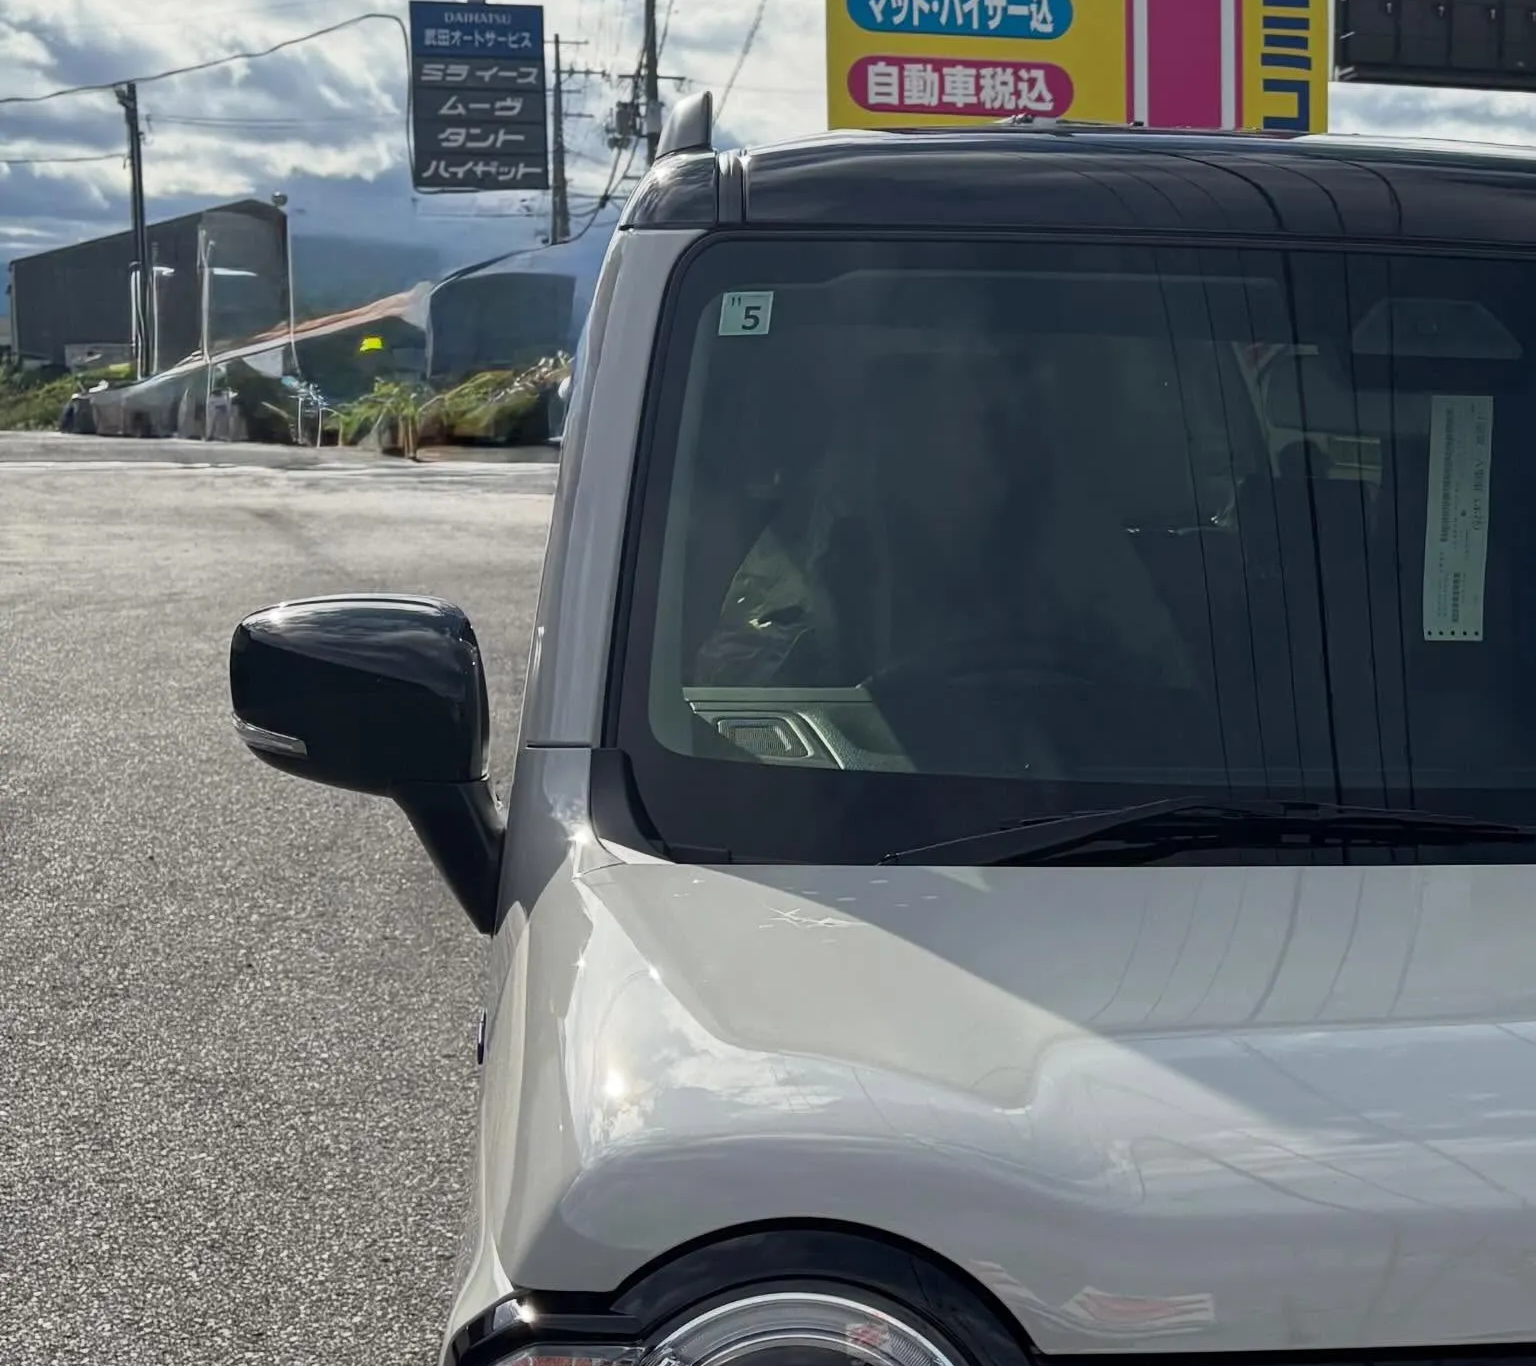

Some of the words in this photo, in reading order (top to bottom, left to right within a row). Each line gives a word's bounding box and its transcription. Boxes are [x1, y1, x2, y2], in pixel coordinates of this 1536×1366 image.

[443, 11, 512, 26] DAIHATSU
[865, 62, 1056, 113] 自動車税込
[437, 95, 524, 117] ムーヴ
[437, 127, 525, 149] タント
[421, 159, 543, 181] ハイゼット
[741, 305, 762, 331] 5
